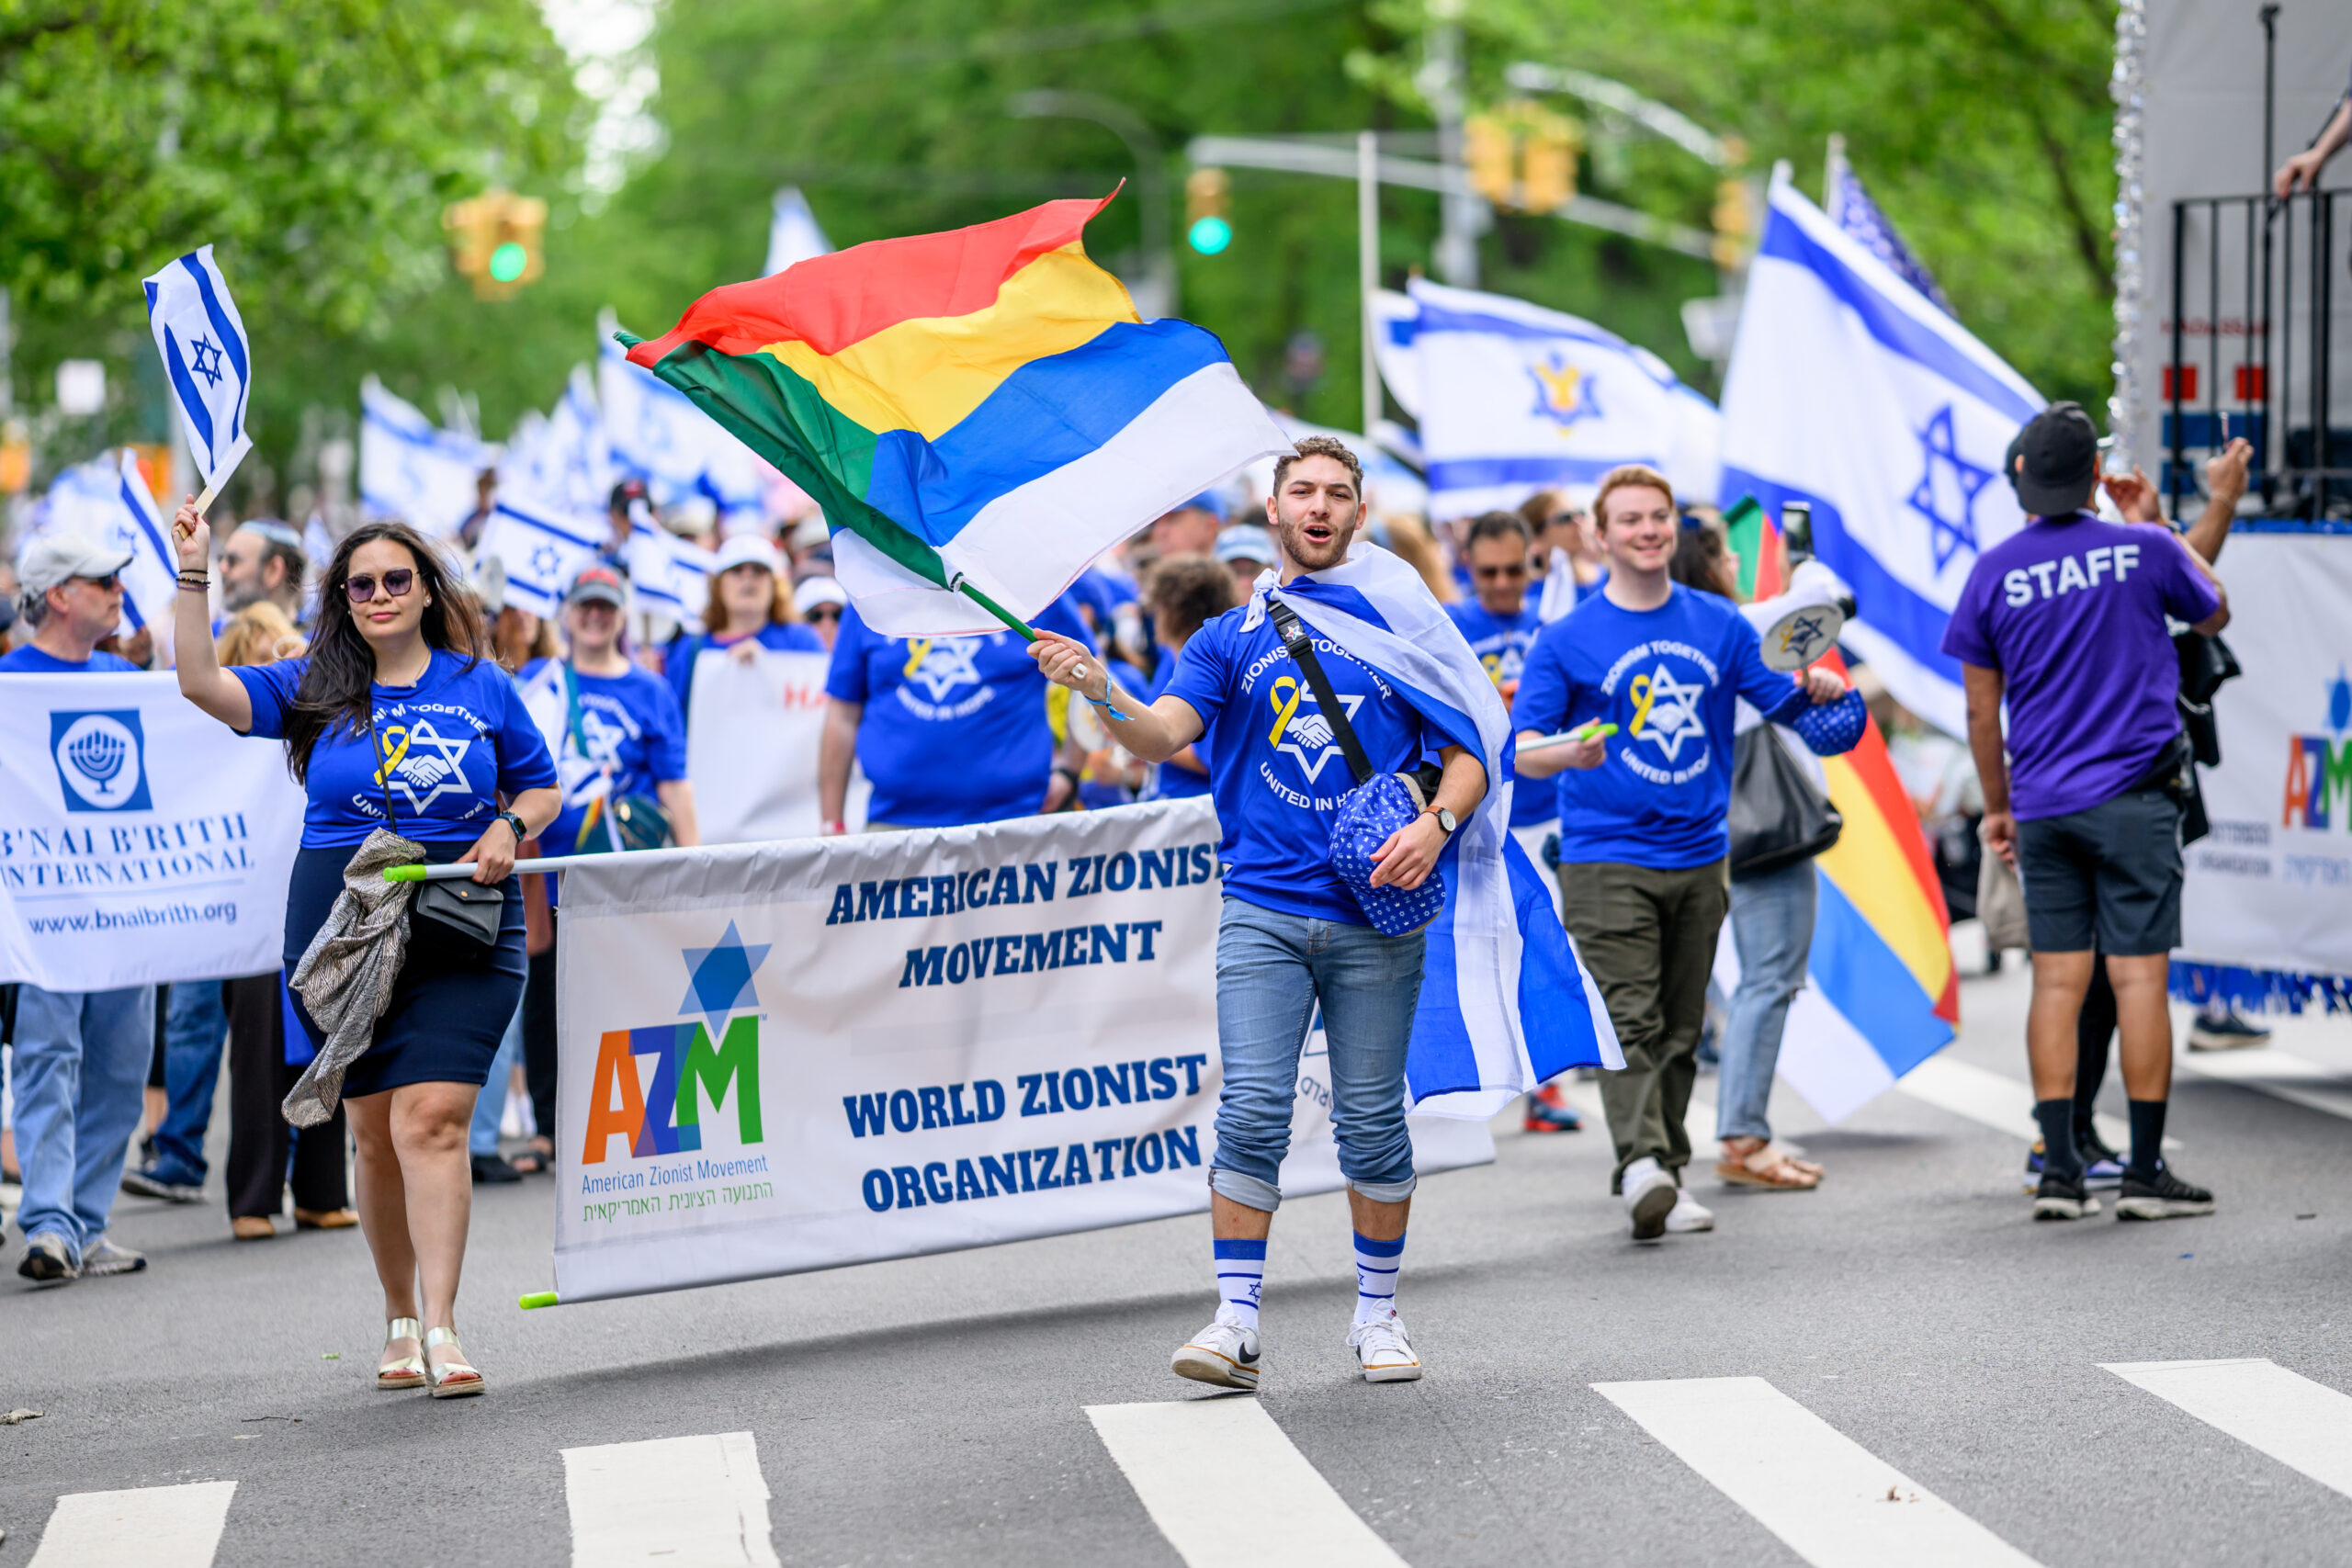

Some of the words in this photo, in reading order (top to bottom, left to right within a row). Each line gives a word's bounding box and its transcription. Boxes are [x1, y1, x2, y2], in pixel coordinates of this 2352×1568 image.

[2004, 545, 2140, 608] STAFF
[1241, 646, 1289, 695] ZIONIS
[1261, 761, 1310, 808] UNITED
[1315, 797, 1333, 811] IN
[110, 812, 247, 854] B'RITH
[0, 847, 255, 889] INTERNATIONAL
[826, 861, 1057, 926] AMERICAN
[28, 903, 237, 934] www.bnaibrith.org
[899, 920, 1162, 988] MOVEMENT
[582, 1014, 763, 1165] AZM
[842, 1079, 1006, 1138] WORLD
[1017, 1054, 1206, 1117] ZIONIST
[582, 1170, 643, 1195] American
[650, 1162, 694, 1186] Zionist
[696, 1154, 768, 1179] Movement
[722, 1181, 774, 1205] התנועה
[862, 1124, 1202, 1213] ORGANIZATION
[583, 1196, 661, 1223] האמריקאית
[669, 1189, 716, 1211] הציונית
